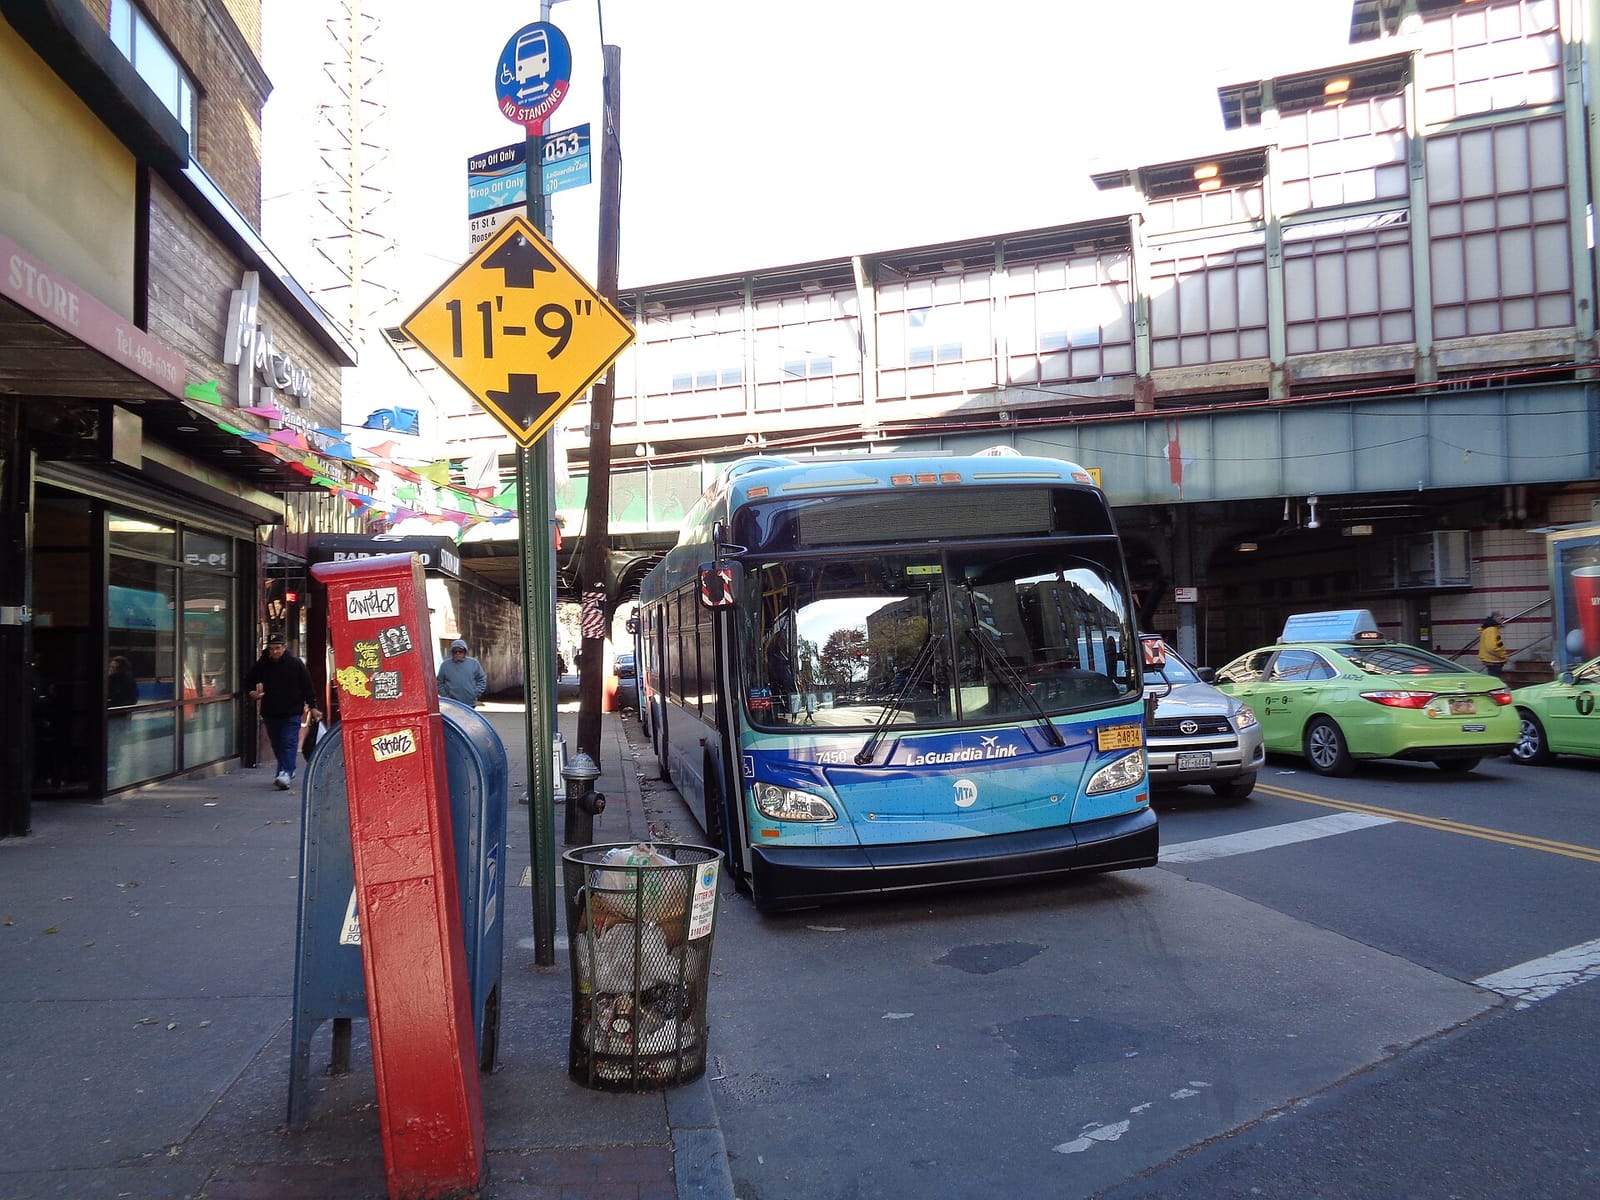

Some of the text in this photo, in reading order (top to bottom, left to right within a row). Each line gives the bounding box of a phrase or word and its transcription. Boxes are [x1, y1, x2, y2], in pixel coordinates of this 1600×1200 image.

[503, 102, 516, 117] NO
[517, 88, 562, 120] STANDING
[546, 133, 579, 161] Q53
[470, 149, 515, 170] Drop Off Only
[470, 178, 524, 199] Drop Off Only
[471, 221, 480, 231] 61
[482, 218, 489, 228] St
[8, 254, 81, 328] STORE
[815, 750, 847, 765] 7450
[906, 743, 1018, 766] LaGuardia Link
[954, 786, 974, 802] MTA
